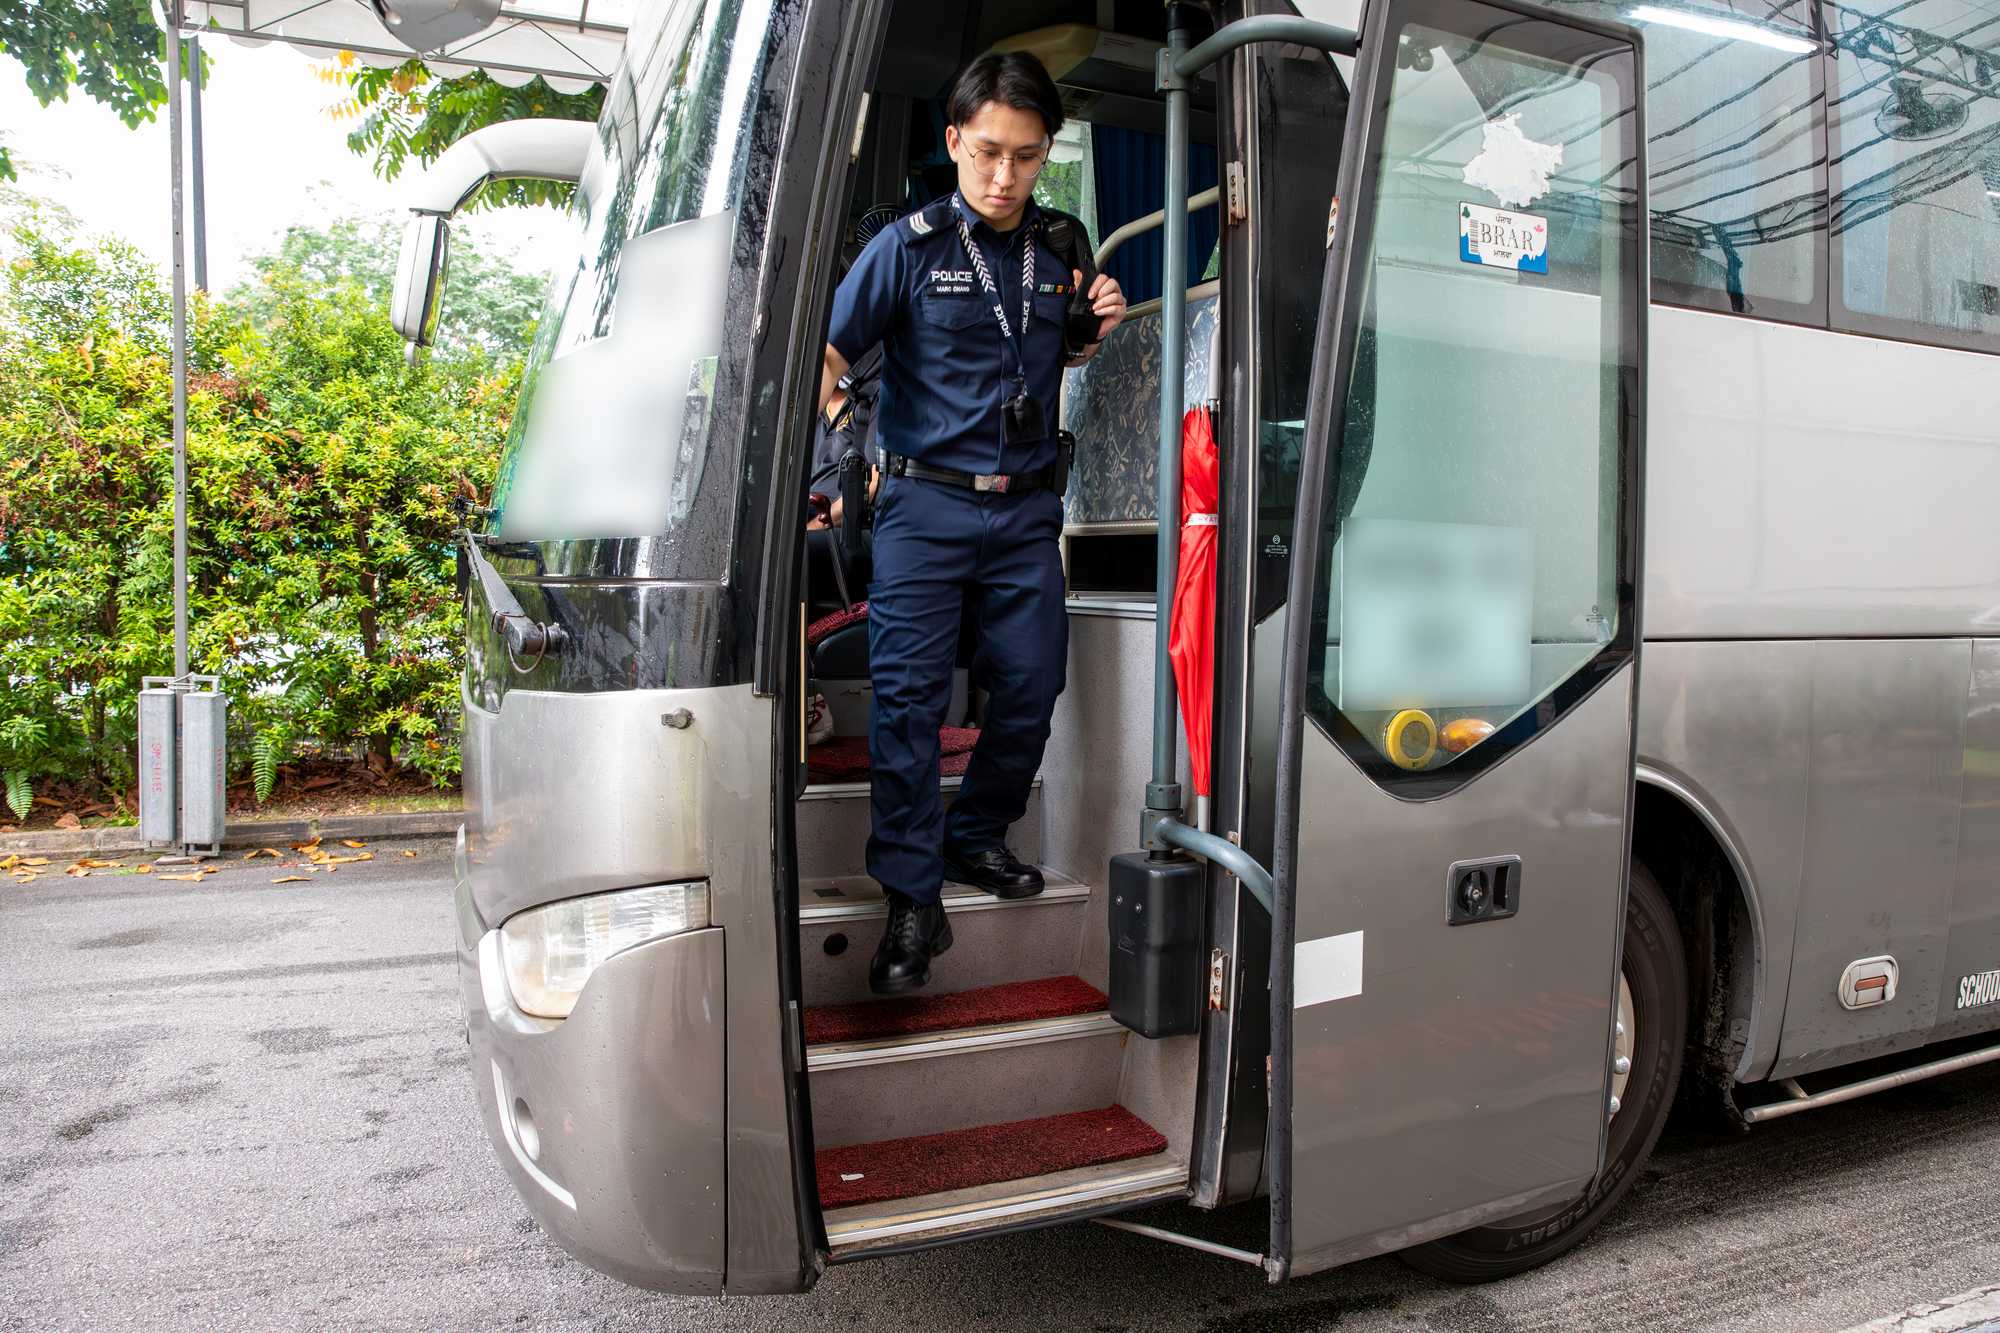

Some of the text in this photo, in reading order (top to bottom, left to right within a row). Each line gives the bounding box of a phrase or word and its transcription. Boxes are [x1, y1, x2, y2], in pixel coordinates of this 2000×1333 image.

[1479, 222, 1534, 251] BRAR
[930, 270, 973, 282] POLICE
[993, 303, 1012, 338] POLICE
[1022, 300, 1031, 334] POLICE
